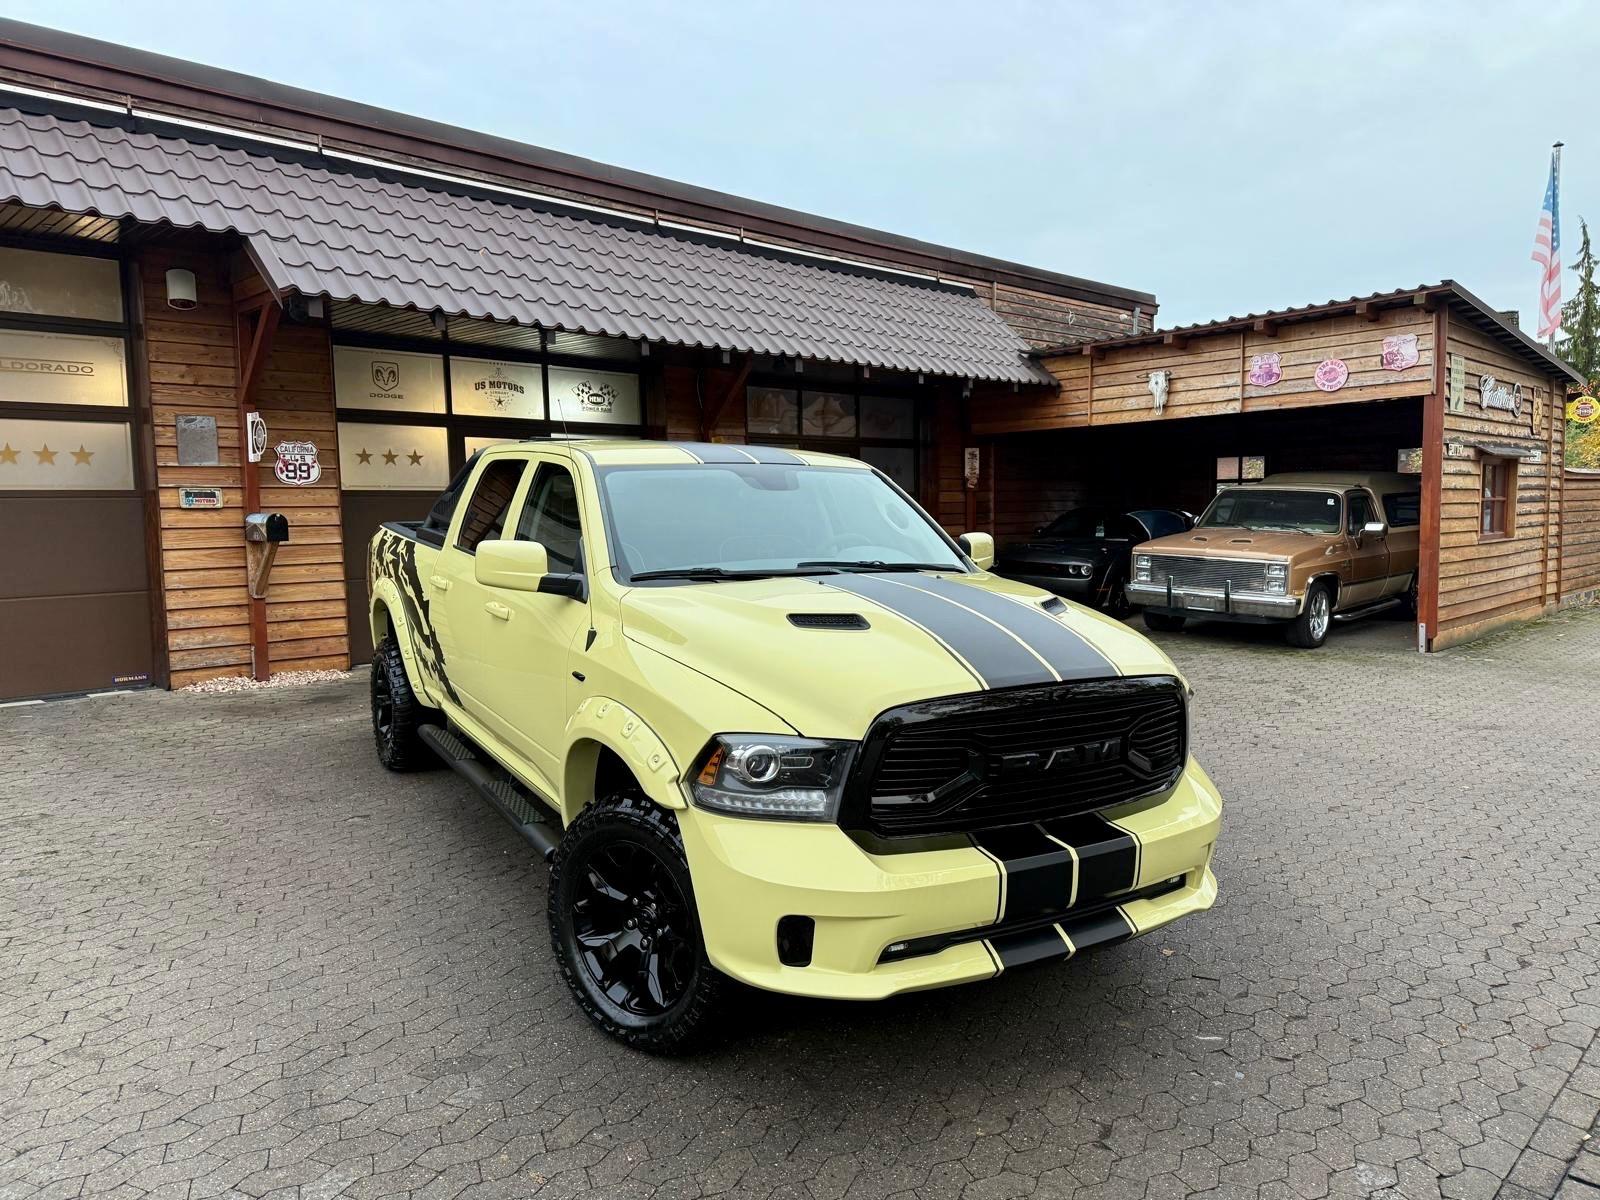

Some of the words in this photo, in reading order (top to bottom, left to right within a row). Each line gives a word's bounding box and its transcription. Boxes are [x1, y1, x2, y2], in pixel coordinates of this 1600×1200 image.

[474, 381, 486, 391] US
[488, 380, 525, 395] MOTORS
[369, 392, 404, 400] DODGE
[279, 444, 315, 453] CALIFORNIA
[285, 462, 311, 480] 99
[1000, 738, 1122, 776] RAM
